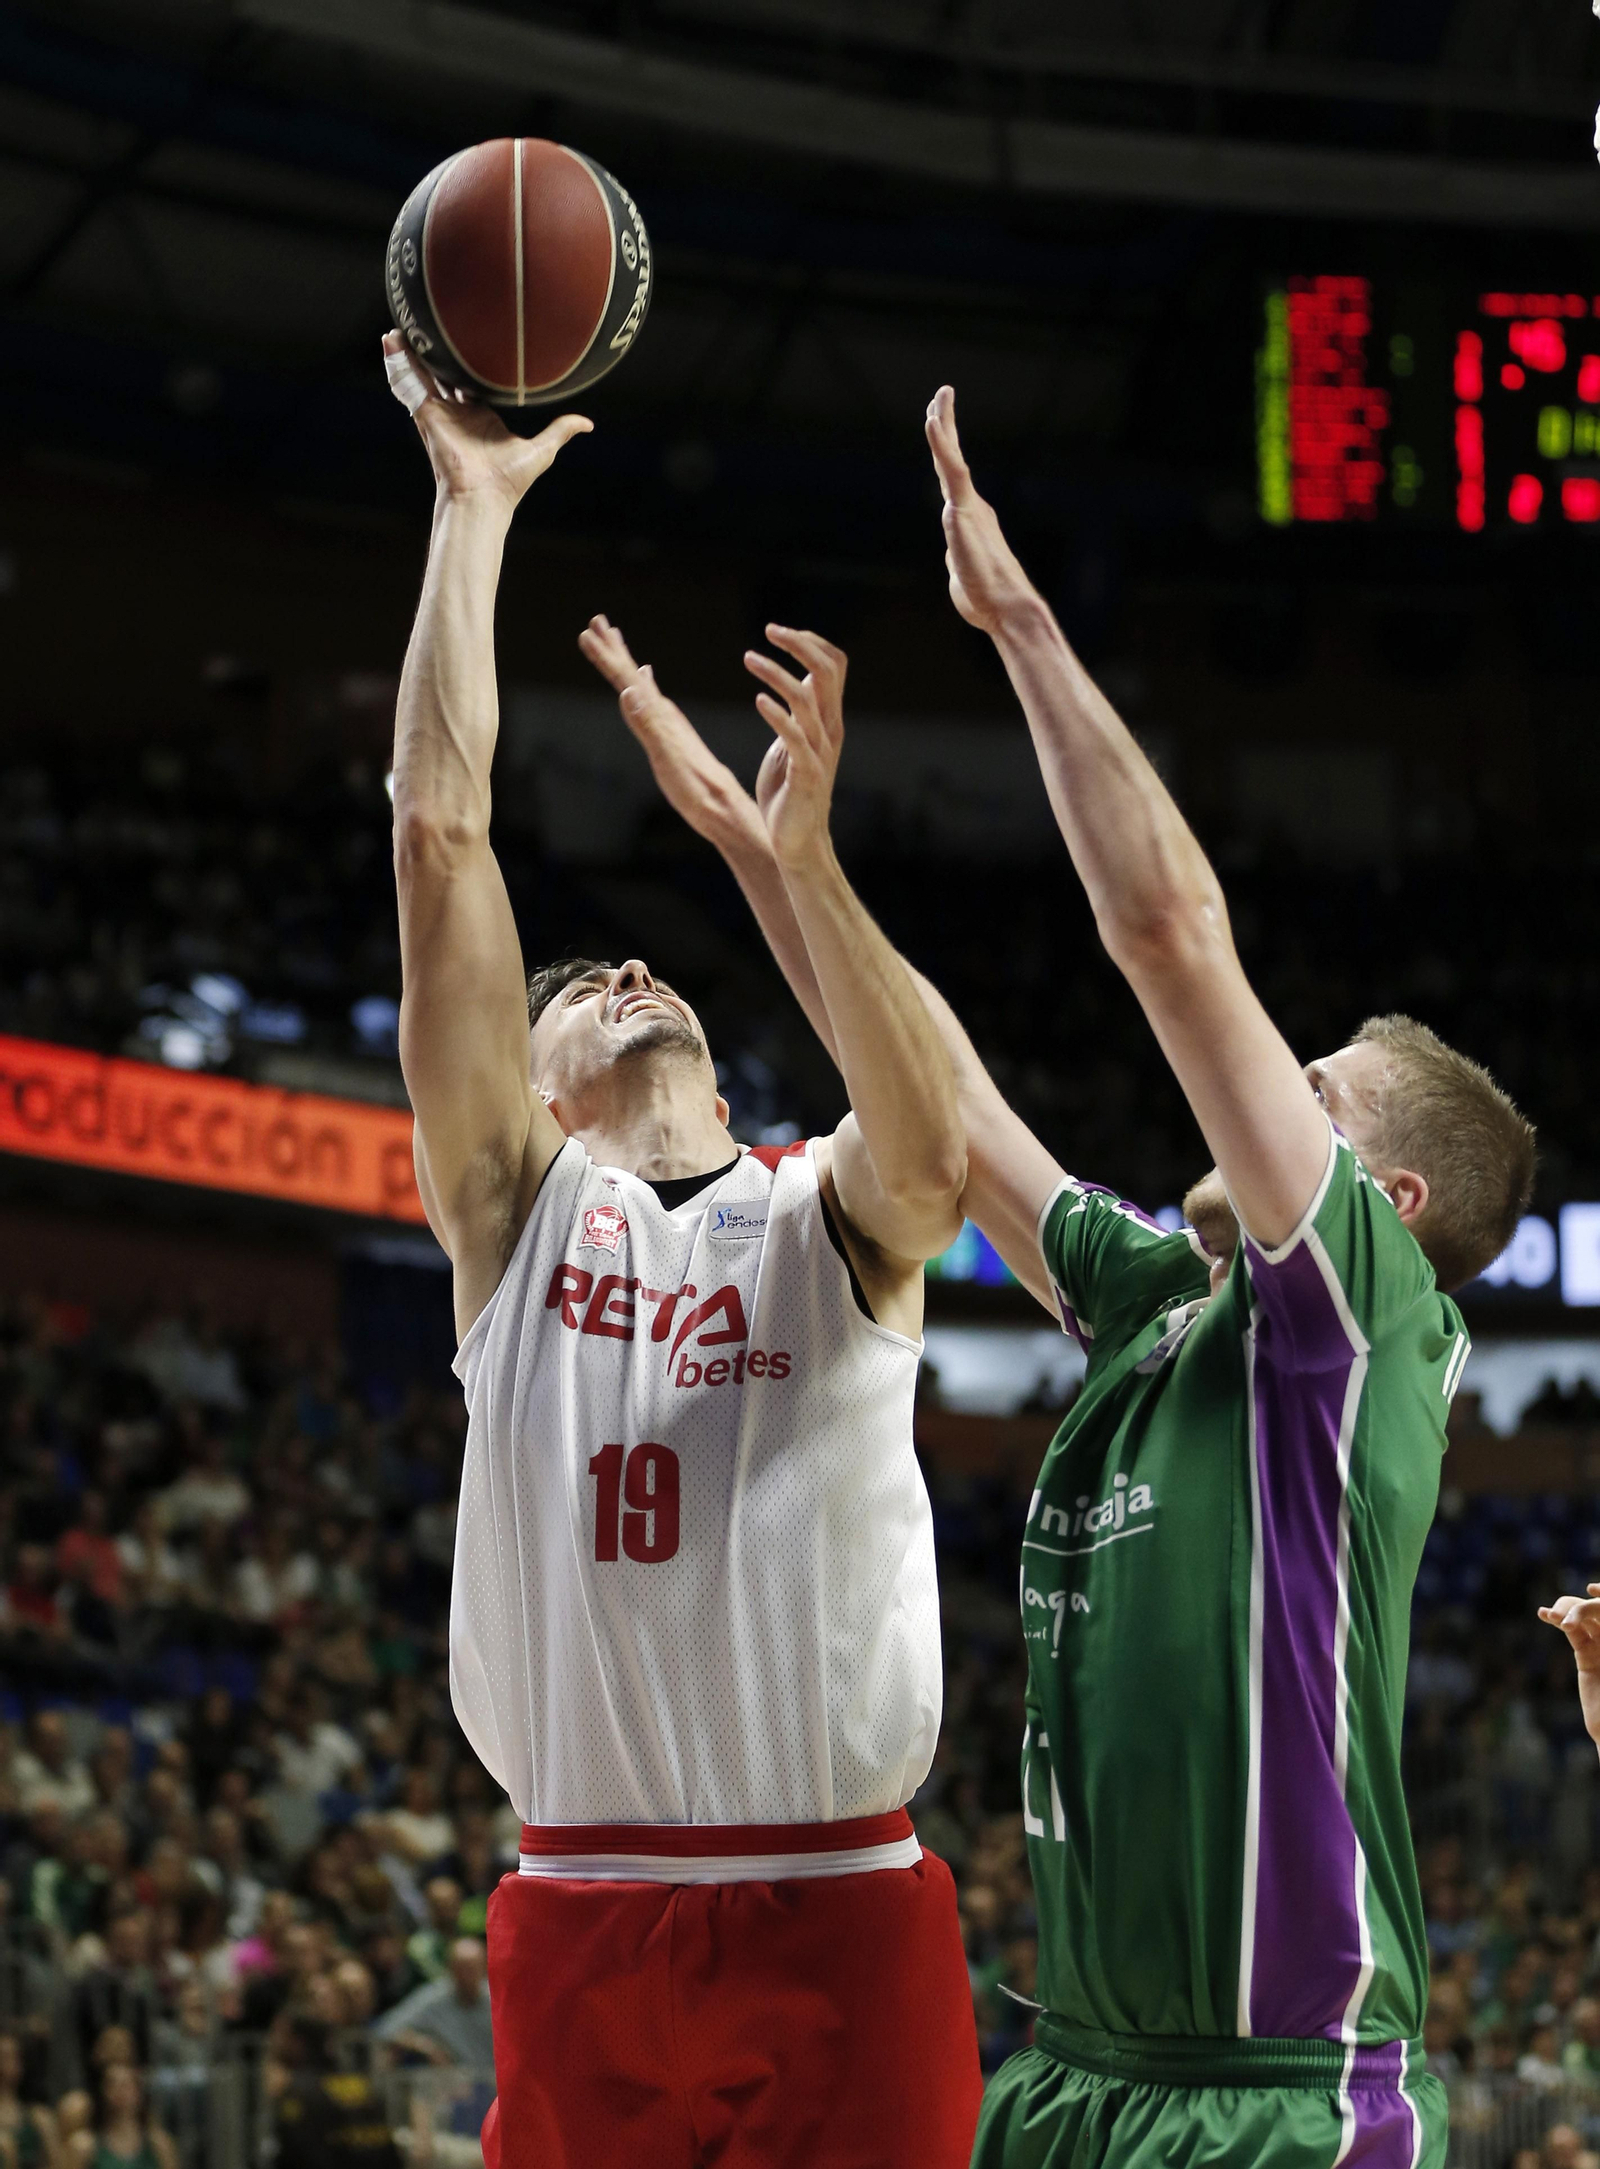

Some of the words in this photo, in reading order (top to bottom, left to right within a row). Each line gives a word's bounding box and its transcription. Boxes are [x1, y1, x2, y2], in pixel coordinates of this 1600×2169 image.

[727, 1212, 745, 1223] liga
[545, 1263, 749, 1377] RETA
[588, 1442, 680, 1564] 19
